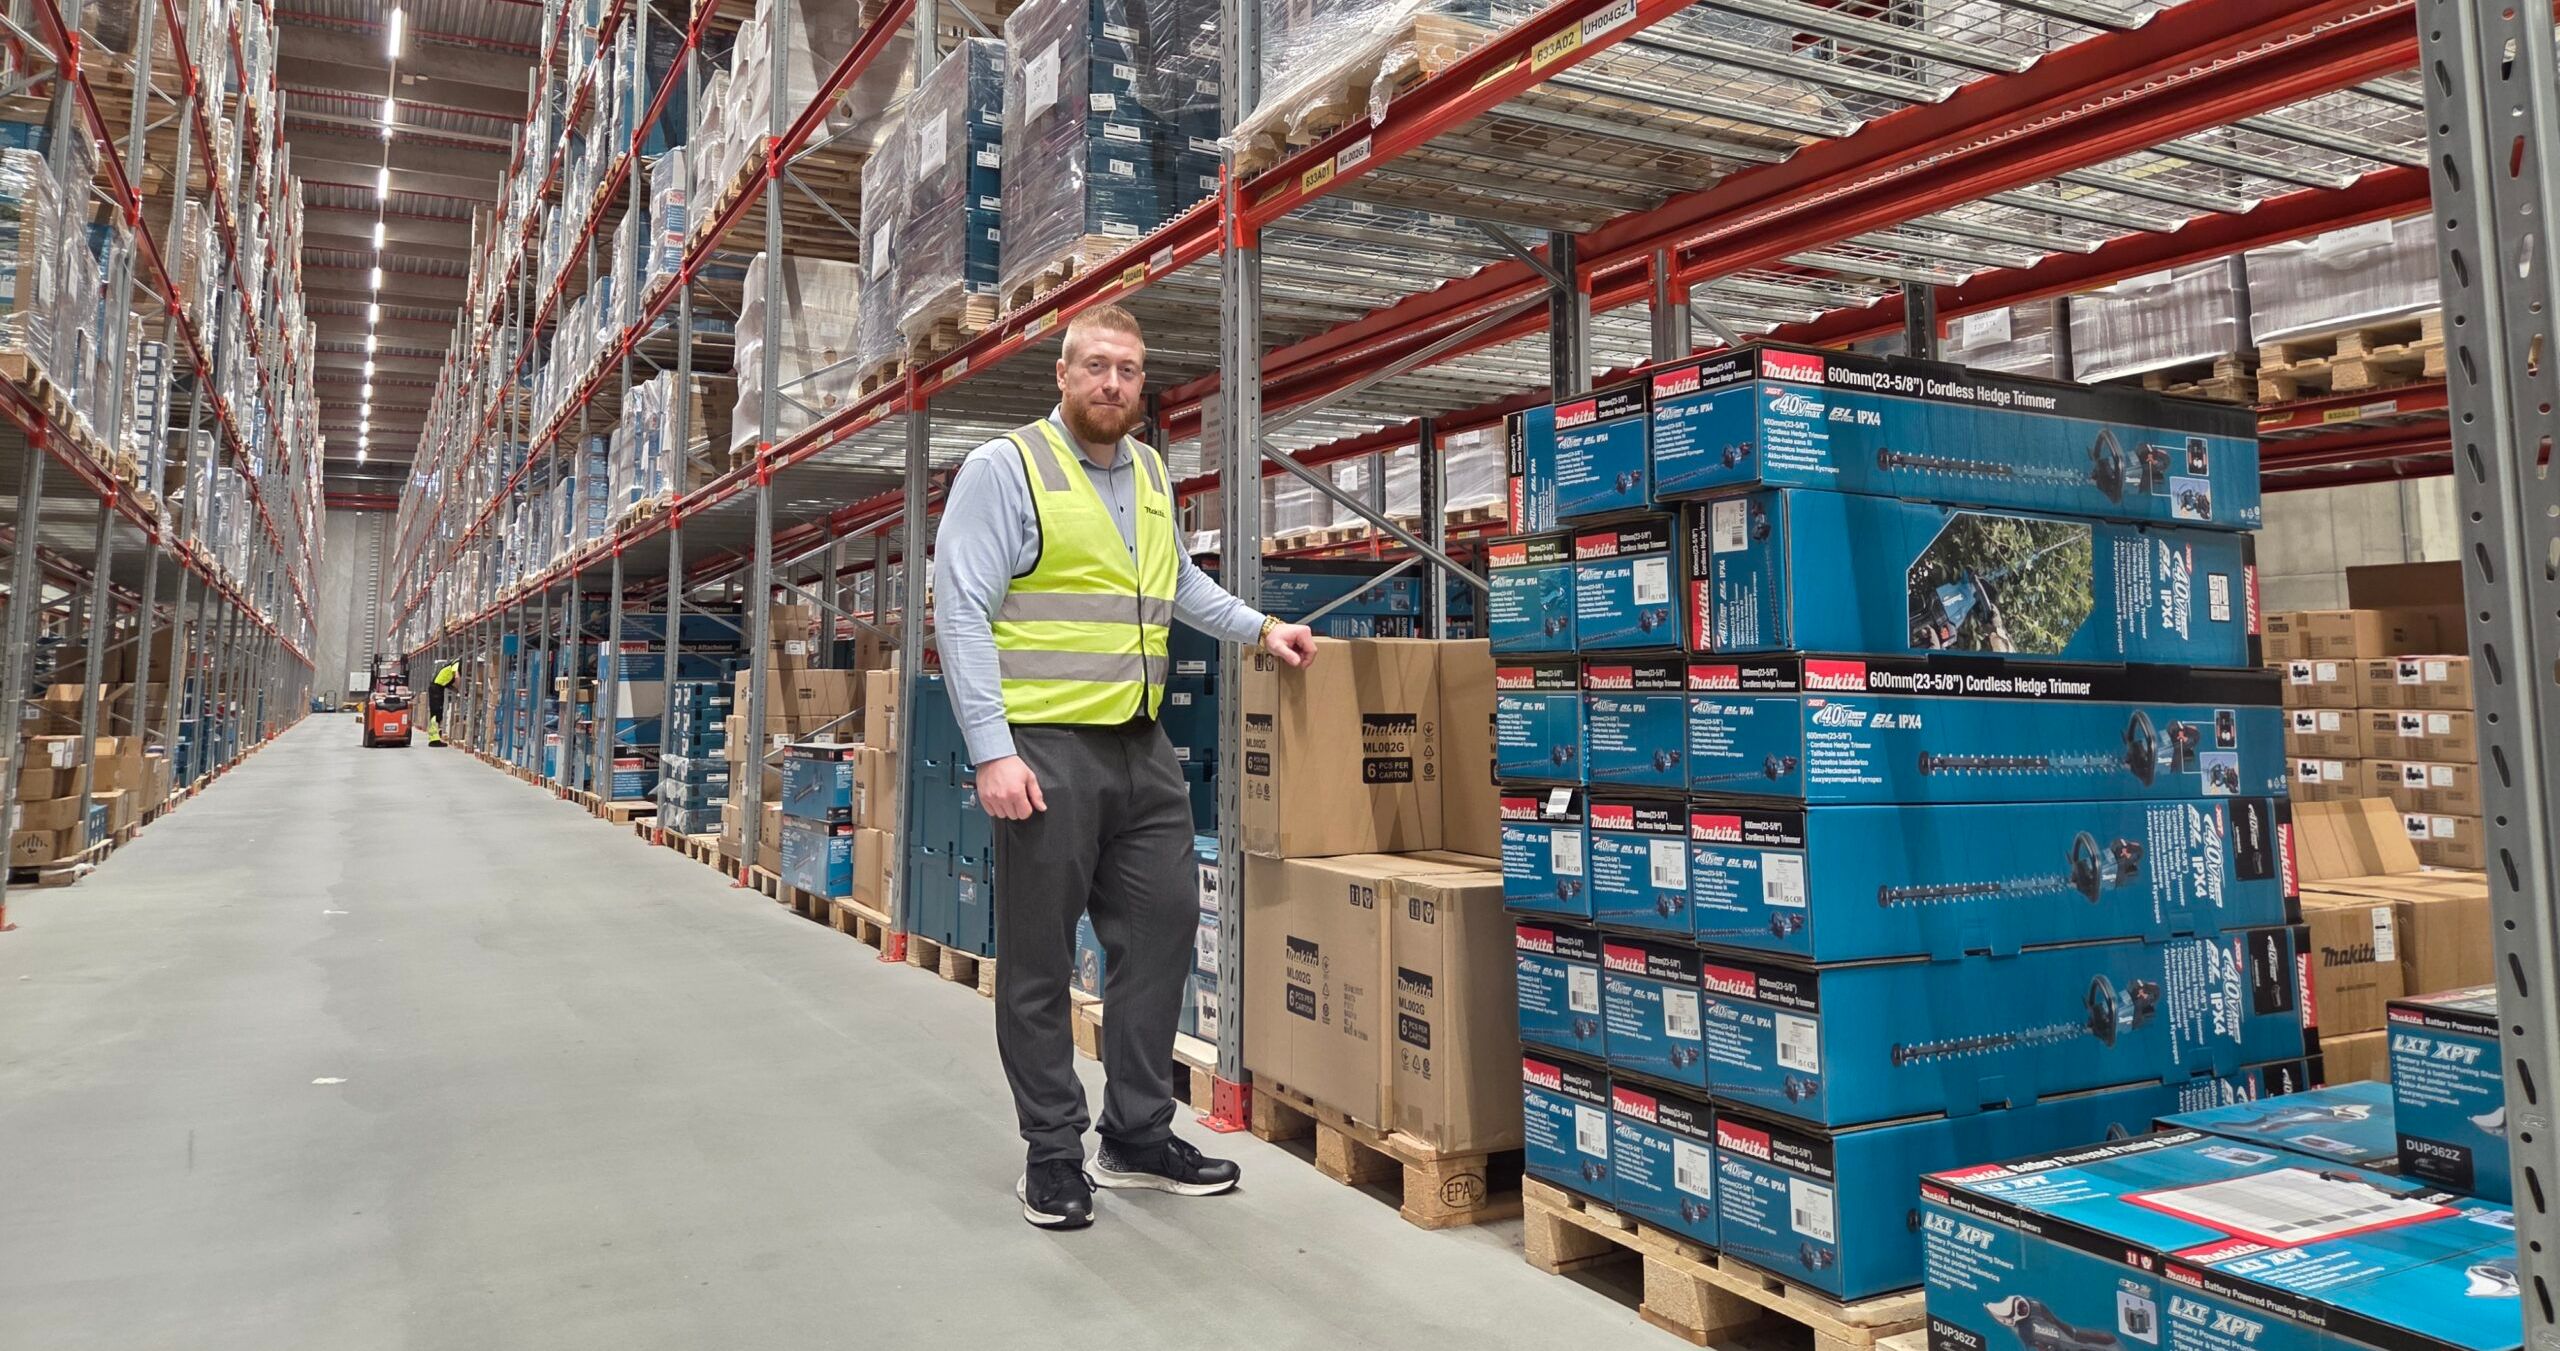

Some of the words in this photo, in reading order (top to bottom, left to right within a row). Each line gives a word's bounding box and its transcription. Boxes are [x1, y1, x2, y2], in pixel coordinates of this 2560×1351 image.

[1584, 4, 1627, 35] UH004GZ
[1537, 32, 1575, 62] 633A02
[1762, 361, 1824, 384] Makita
[1828, 367, 1924, 396] 600mm(23-5/8")
[1927, 380, 1974, 400] Cordless
[1977, 386, 2010, 406] Hedge
[2013, 388, 2056, 410] Trimmer
[1857, 410, 1881, 426] IPX4
[2161, 589, 2174, 629] IPX4
[1805, 670, 1867, 691] Makita
[1870, 671, 1964, 694] 600mm(23-5/8")
[1966, 675, 2012, 693] Cordless
[2015, 677, 2047, 696] Hedge
[2049, 679, 2090, 695] Trimmer
[1899, 714, 1922, 729] IPX4
[1363, 742, 1405, 753] ML002G
[1248, 757, 1253, 769] 6
[1367, 763, 1376, 777] 6
[1379, 761, 1393, 769] PCS
[1395, 761, 1409, 769] PER
[1379, 771, 1408, 779] CARTON
[2192, 856, 2207, 898] IPX4
[1287, 967, 1311, 985] ML002G
[1289, 989, 1295, 1006] 6
[1399, 998, 1425, 1015] ML002G
[2211, 992, 2226, 1035] IPX4
[1402, 1019, 1408, 1036] 6
[2425, 1017, 2450, 1029] Battery
[2452, 1021, 2482, 1033] Powered
[2431, 1040, 2481, 1065] XPT
[2406, 1139, 2461, 1161] DUP362Z
[1951, 1196, 1970, 1211] Battery
[1972, 1203, 1996, 1218] Powered
[1997, 1212, 2020, 1227] Pruning
[2020, 1219, 2041, 1233] Shears
[1955, 1222, 1995, 1249] XPT
[2204, 1280, 2231, 1297] Battery
[2232, 1289, 2265, 1308] Powered
[2266, 1300, 2296, 1318] Pruning
[2298, 1309, 2326, 1326] Shears
[1933, 1321, 1977, 1348] DUP362Z
[2210, 1310, 2263, 1342] XPT
